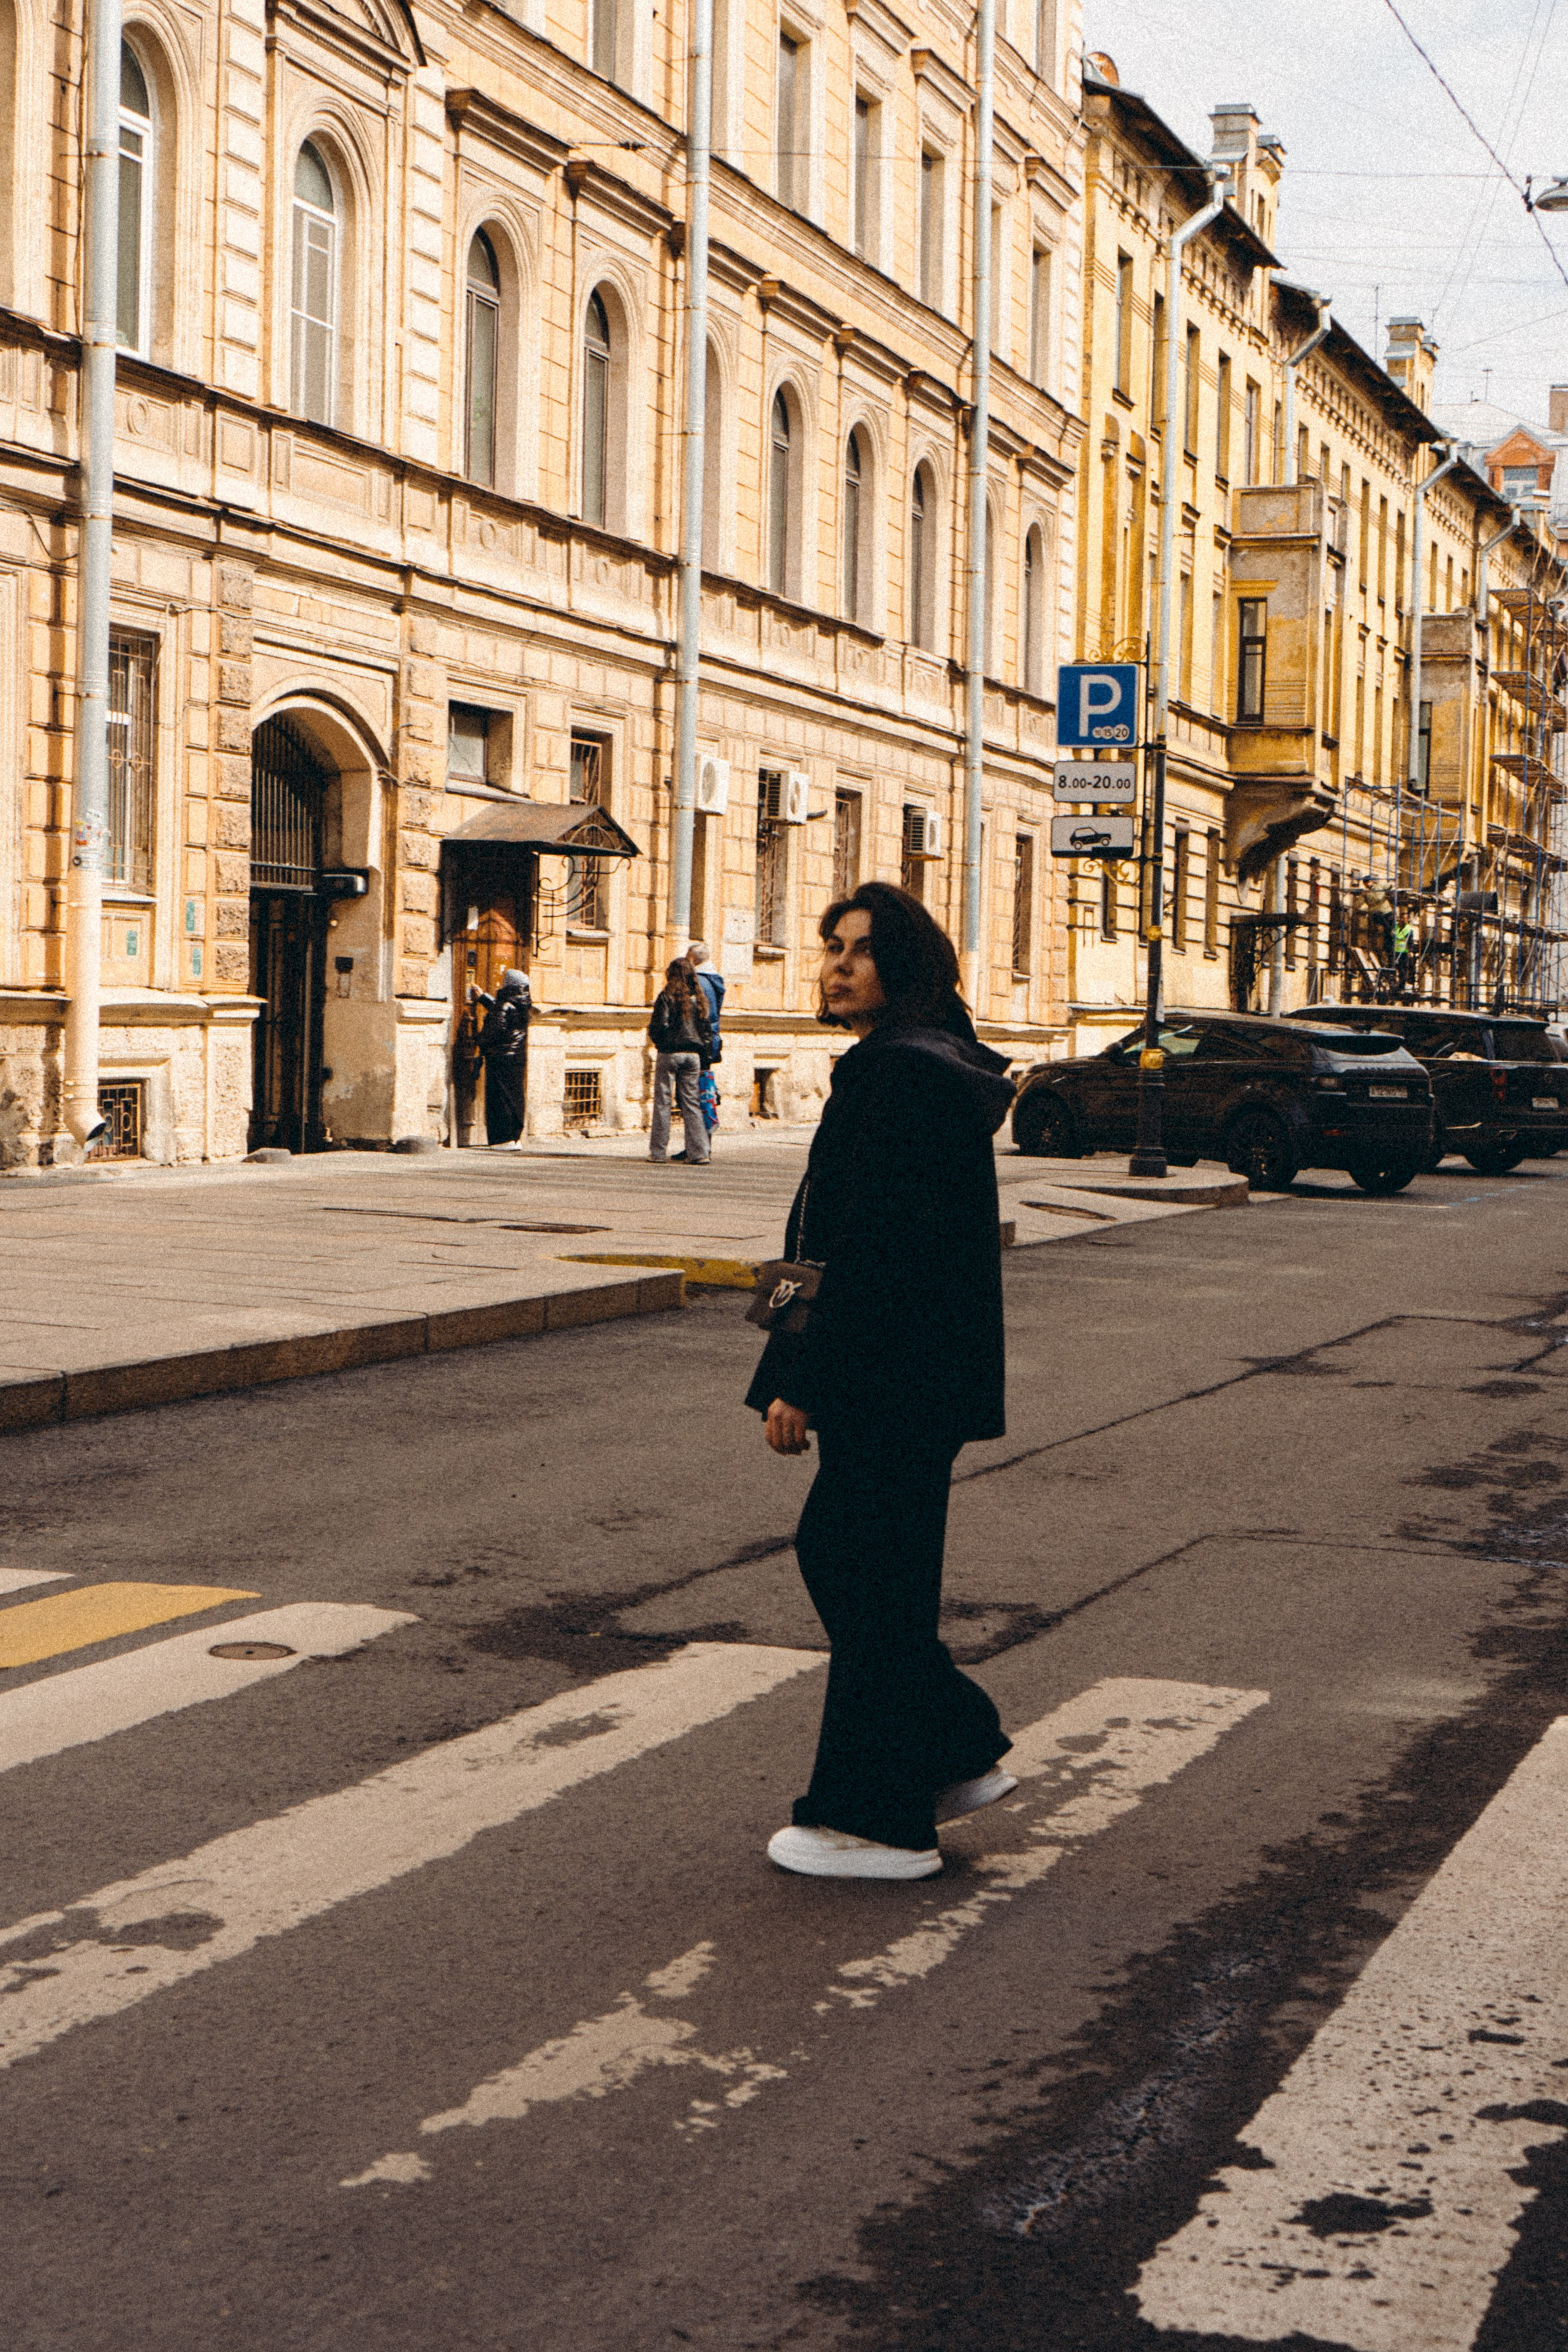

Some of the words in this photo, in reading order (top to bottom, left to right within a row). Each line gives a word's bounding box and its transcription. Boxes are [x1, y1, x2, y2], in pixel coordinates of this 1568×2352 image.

[1079, 674, 1121, 737] P
[1115, 728, 1128, 737] 20
[1058, 775, 1131, 788] 8.00-20.00
